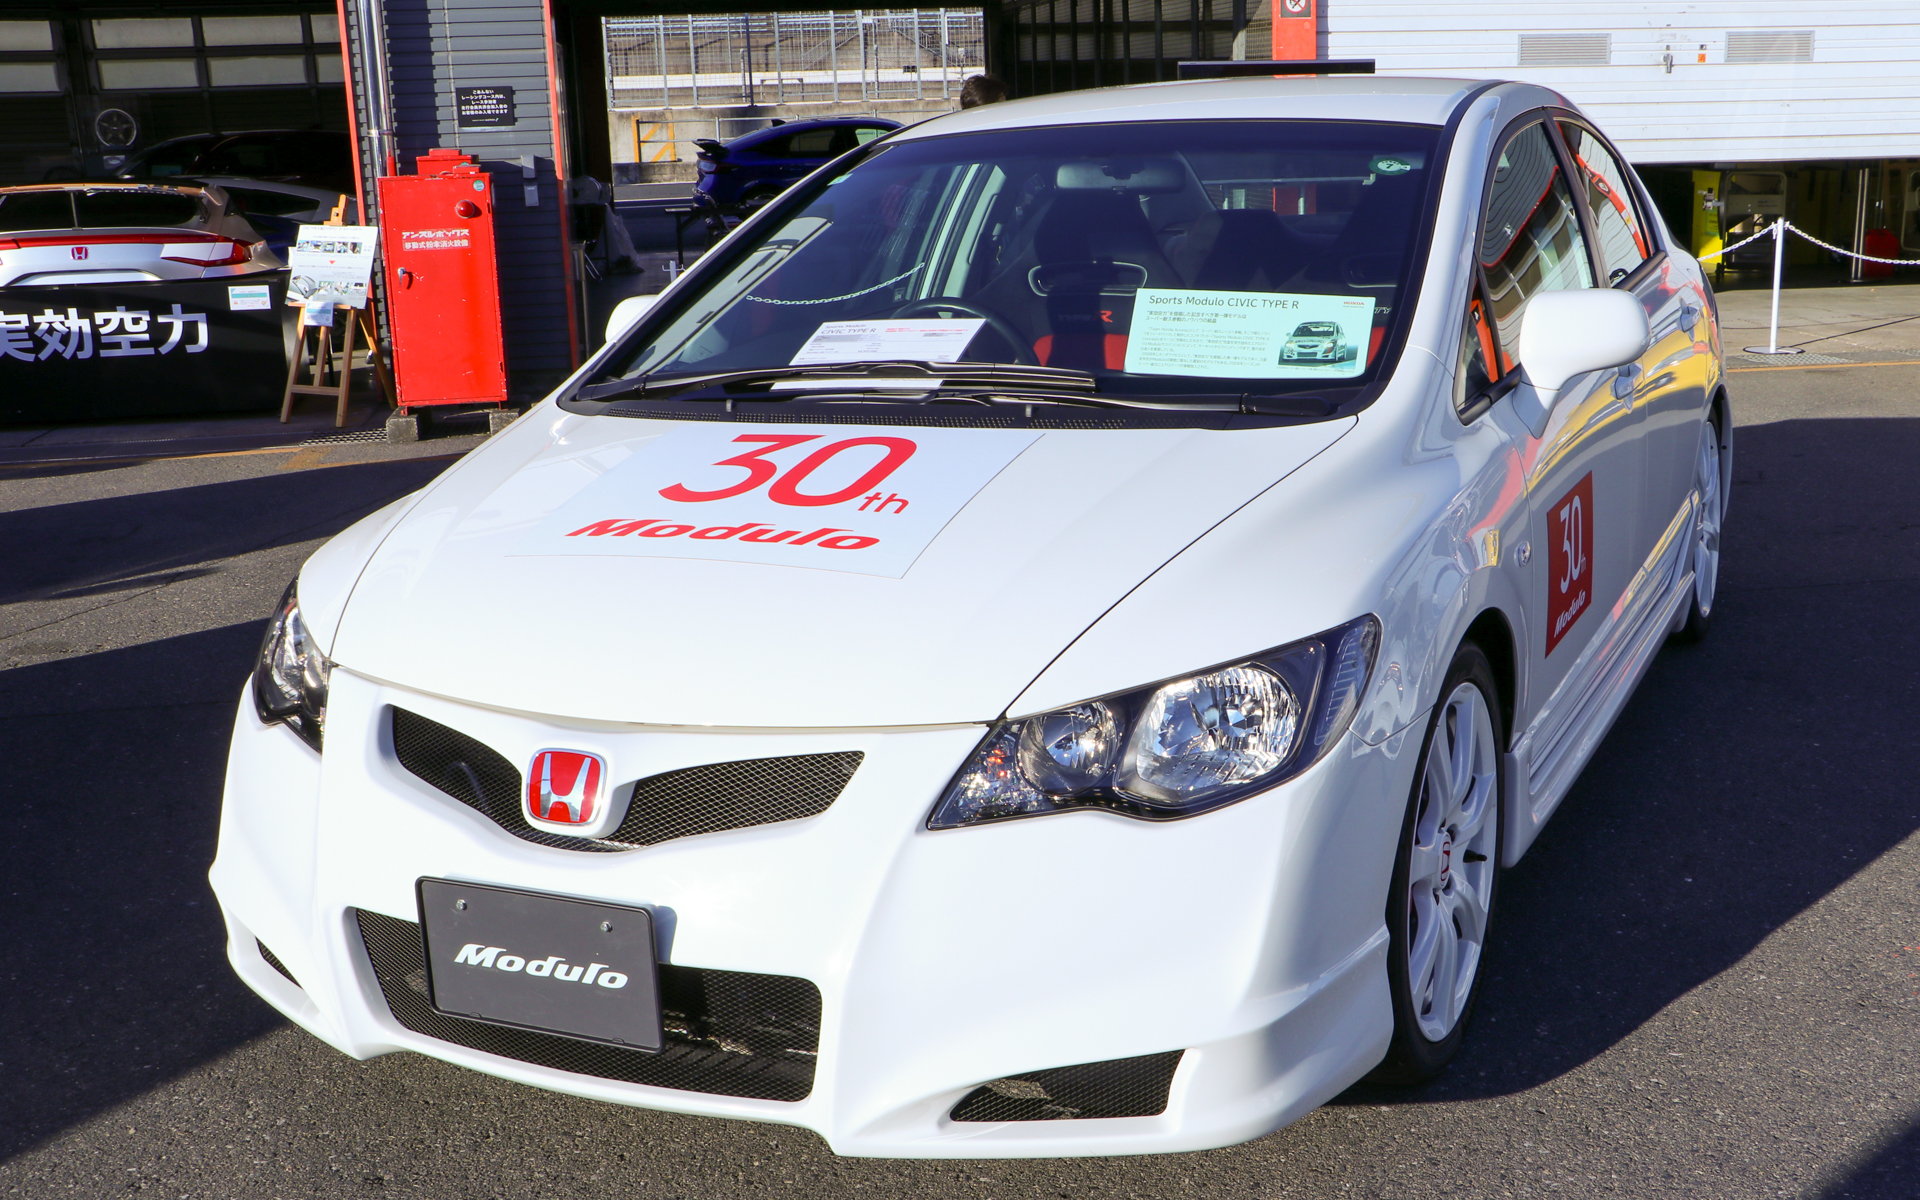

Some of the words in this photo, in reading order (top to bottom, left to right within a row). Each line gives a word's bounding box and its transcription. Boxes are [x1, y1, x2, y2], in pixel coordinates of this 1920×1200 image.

[1149, 295, 1183, 304] Sports
[1185, 296, 1225, 306] Modulo
[1227, 298, 1258, 308] CIVIC
[1262, 299, 1289, 308] TYPE
[1292, 300, 1300, 310] R
[0, 304, 209, 362] 実効空力
[564, 518, 880, 550] Modulo
[1554, 589, 1586, 638] Modulo
[454, 943, 629, 989] Modulo
